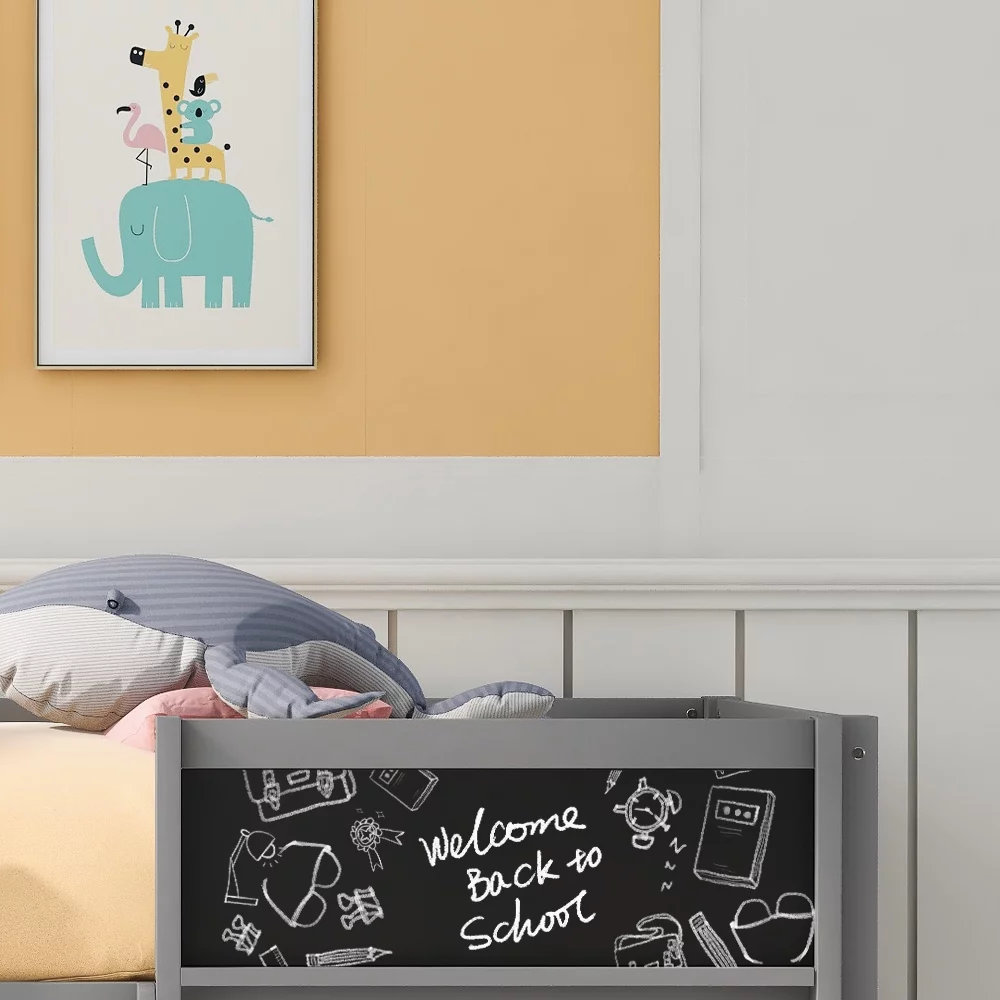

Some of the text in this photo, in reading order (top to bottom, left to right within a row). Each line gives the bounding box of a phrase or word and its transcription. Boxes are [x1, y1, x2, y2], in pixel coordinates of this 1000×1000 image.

[418, 806, 587, 867] Welcome
[466, 846, 603, 902] Back to
[459, 889, 597, 950] School
